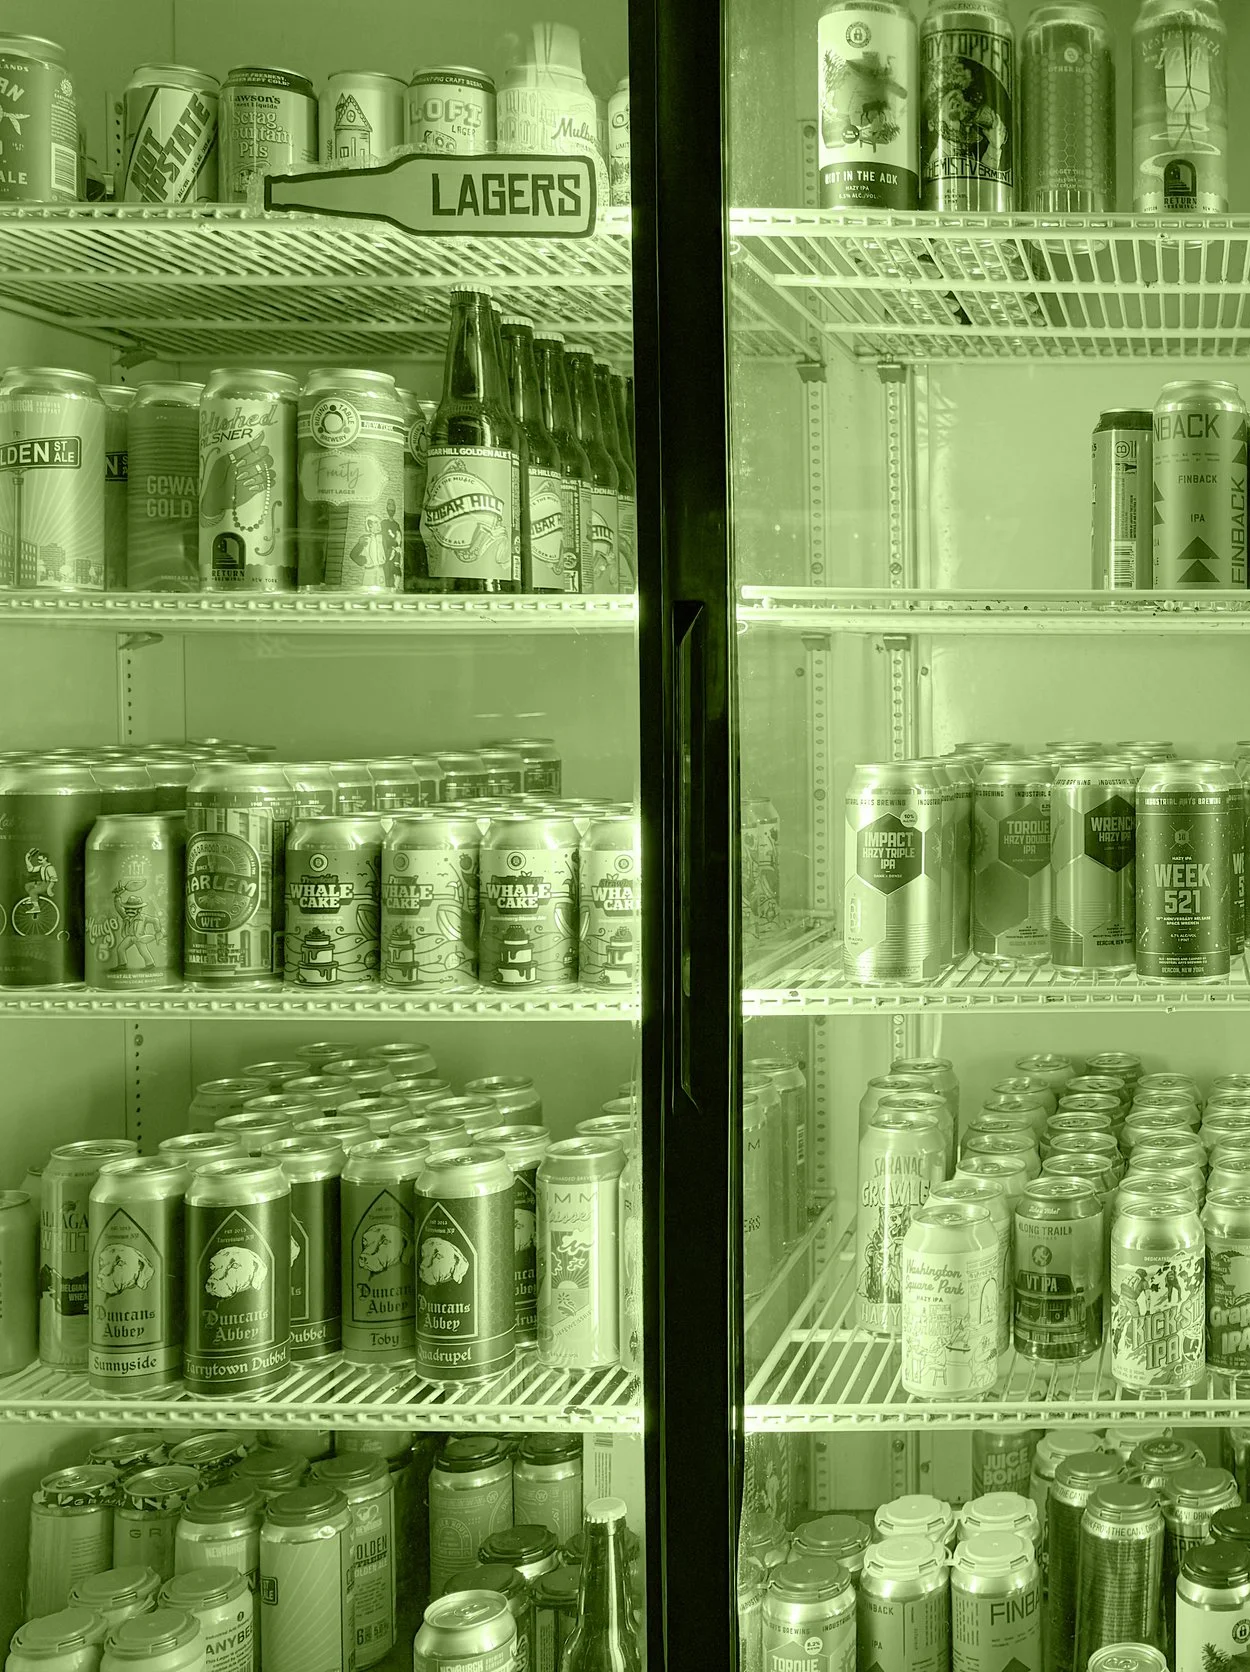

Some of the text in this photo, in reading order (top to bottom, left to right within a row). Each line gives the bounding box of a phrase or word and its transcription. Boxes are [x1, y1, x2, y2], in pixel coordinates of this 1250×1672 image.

[232, 111, 277, 128] Scrag
[239, 144, 269, 158] Pils
[844, 170, 853, 181] IN
[857, 170, 875, 181] THE
[431, 173, 582, 217] LAGERS
[339, 404, 354, 424] TABLE
[320, 433, 346, 443] BREWERY
[54, 442, 68, 452] ST
[443, 449, 460, 457] HILL
[460, 450, 493, 458] GOLDEN
[54, 453, 75, 463] ALE
[1178, 475, 1217, 484] FINBACK
[147, 499, 192, 517] GOLD
[426, 495, 501, 522] SUGAR HILL
[1190, 514, 1205, 523] IPA
[1231, 477, 1245, 584] FINBACK
[1145, 797, 1177, 805] INDUSTRIAL
[1006, 820, 1050, 834] TORQUE
[864, 832, 914, 847] IMPACT
[1003, 835, 1024, 845] HAZY
[1099, 832, 1119, 842] HAZY
[862, 848, 915, 858] HAZY TRIPLE
[1023, 847, 1036, 857] IPA
[880, 860, 896, 869] IPA
[1154, 864, 1210, 888] WEEK
[291, 884, 353, 899] WHALE
[487, 884, 551, 899] WHALE
[300, 897, 340, 909] CAKE
[386, 897, 421, 909] CAKE
[497, 897, 539, 909] CAKE
[1164, 891, 1200, 914] 521
[200, 917, 221, 928] WIT
[1021, 1225, 1070, 1240] LONG TRAIL
[904, 1260, 963, 1283] Washington
[939, 1280, 966, 1300] Park
[1027, 1277, 1058, 1292] VT IPA
[96, 1304, 156, 1322] Duncans
[418, 1297, 472, 1316] Duncans
[424, 1315, 461, 1333] Abbey
[104, 1324, 145, 1342] Abbey
[214, 1330, 260, 1348] Abbey
[370, 1332, 400, 1347] Toby
[416, 1347, 472, 1364] Quadrupel
[1147, 1335, 1180, 1370] IPA
[93, 1357, 158, 1375] Sunnyside
[185, 1349, 288, 1382] Tarrytown Dubbel
[872, 1638, 883, 1650] IPA
